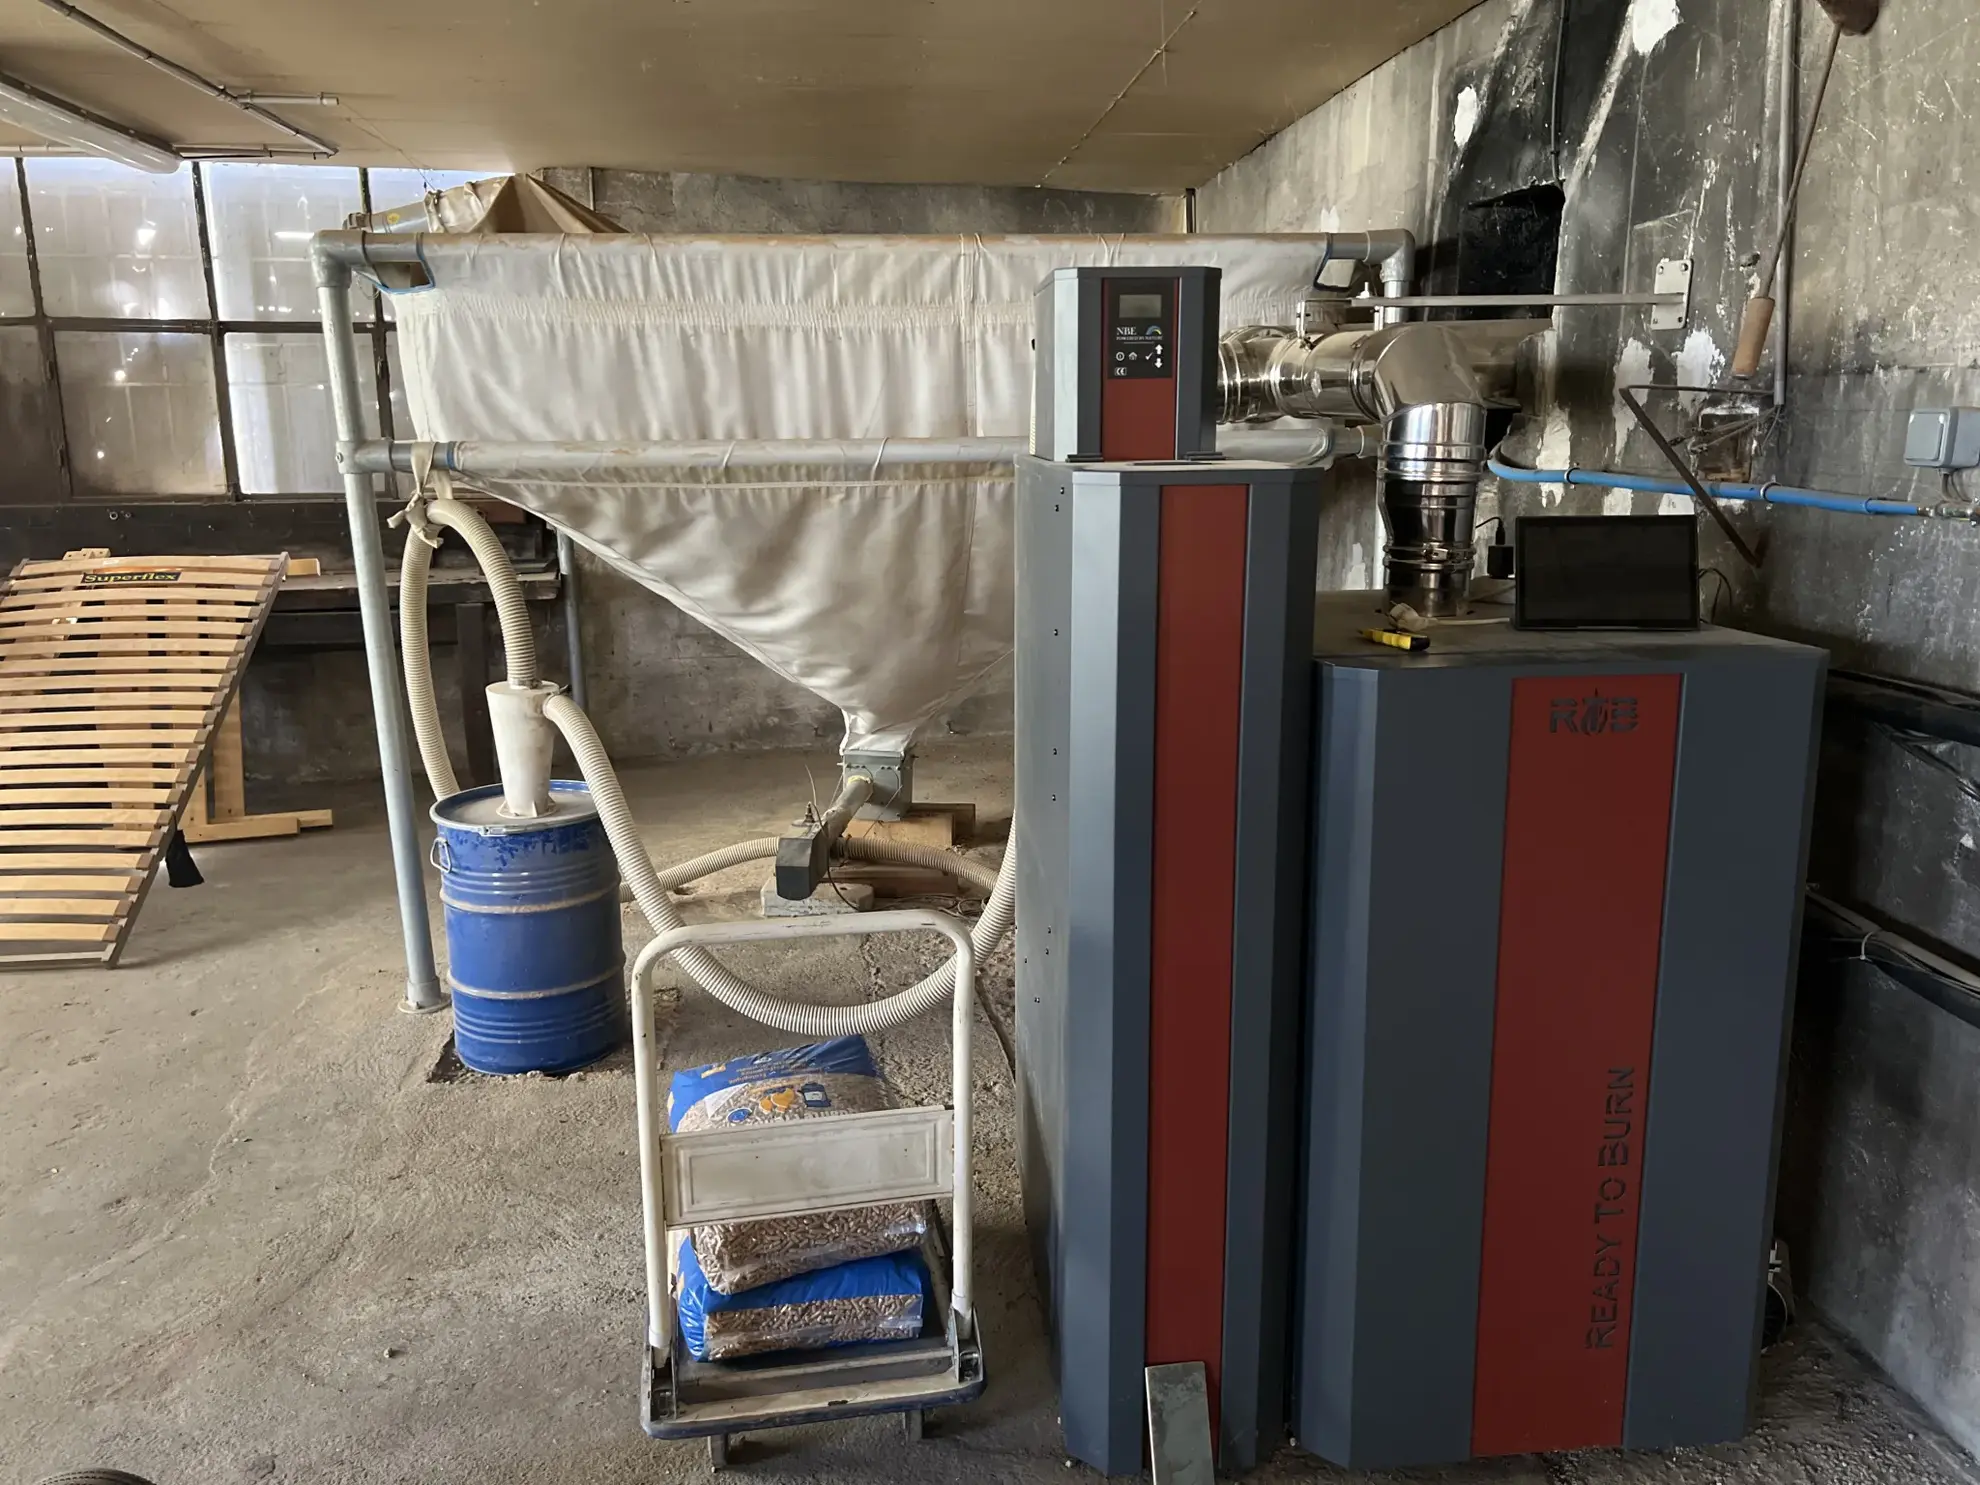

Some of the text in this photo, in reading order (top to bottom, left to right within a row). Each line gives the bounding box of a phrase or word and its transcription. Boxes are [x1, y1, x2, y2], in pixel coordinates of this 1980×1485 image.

[1116, 326, 1137, 335] NBE
[85, 572, 177, 583] Superflex
[1584, 1065, 1635, 1350] READY TO BURN
